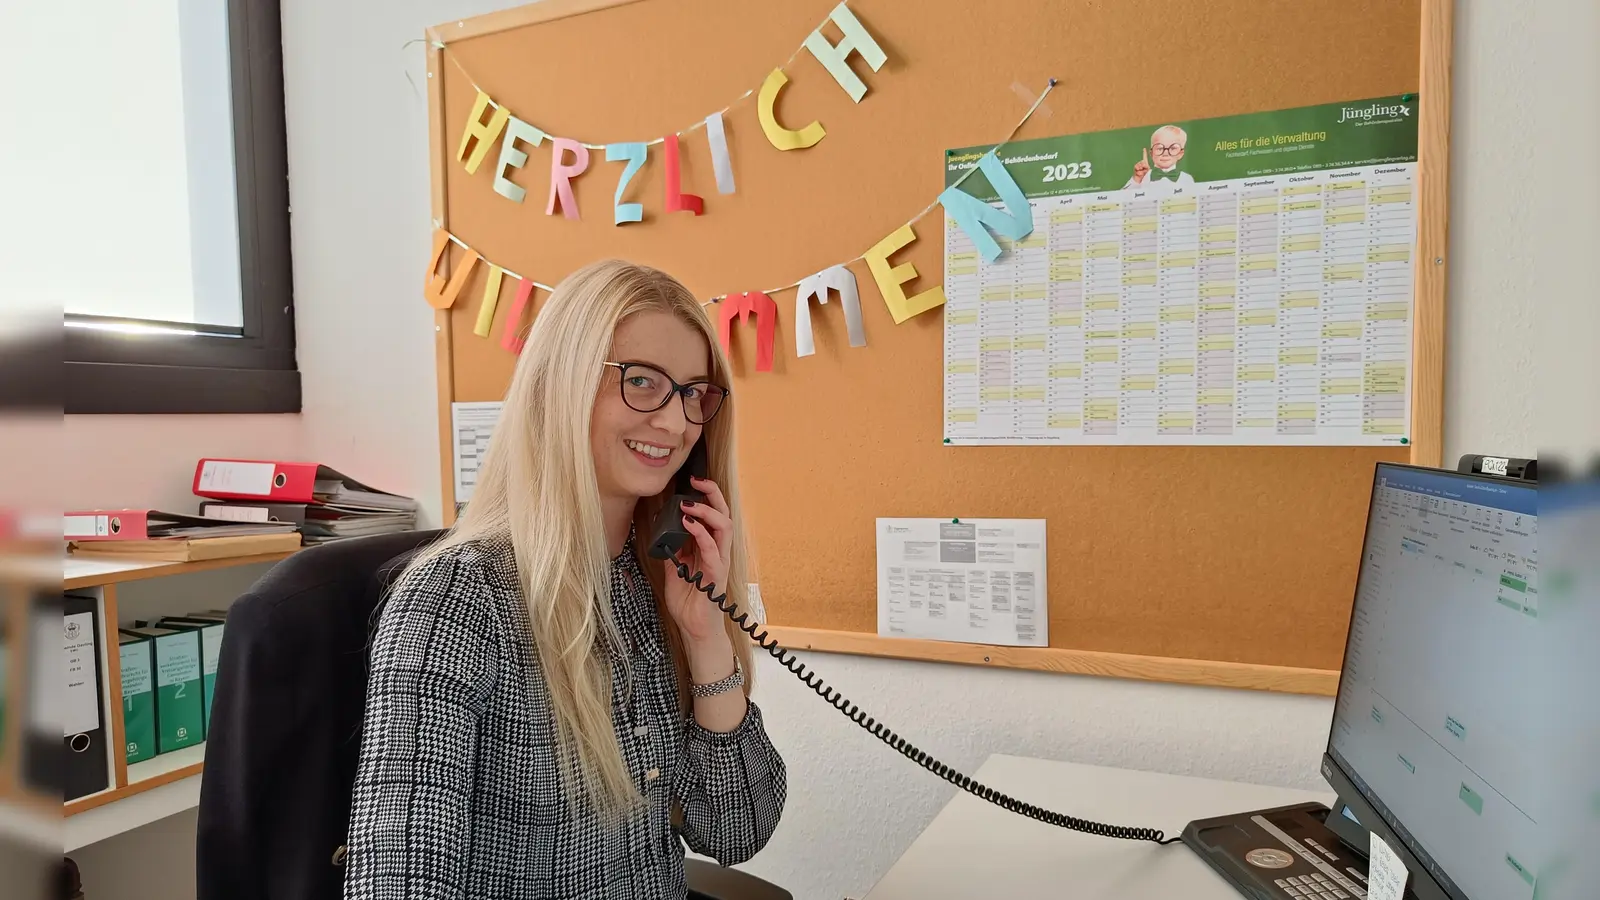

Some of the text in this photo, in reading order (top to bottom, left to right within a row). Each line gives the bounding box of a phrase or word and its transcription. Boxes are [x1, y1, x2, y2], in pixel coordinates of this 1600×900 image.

[457, 2, 888, 226] HERZLICH
[1337, 103, 1399, 124] Jüngling
[1215, 131, 1326, 151] Alles für die Verwaltung
[948, 162, 958, 171] Ihr
[1004, 151, 1058, 165] Behördenbedarf
[1042, 161, 1092, 183] 2023
[1060, 198, 1073, 206] April
[1173, 187, 1183, 195] Juli
[1208, 183, 1228, 191] August
[1243, 179, 1275, 188] September
[1288, 175, 1315, 183] Oktober
[1329, 171, 1361, 179] November
[1374, 167, 1407, 175] Dezember
[174, 681, 186, 699] 2
[123, 694, 133, 712] 1
